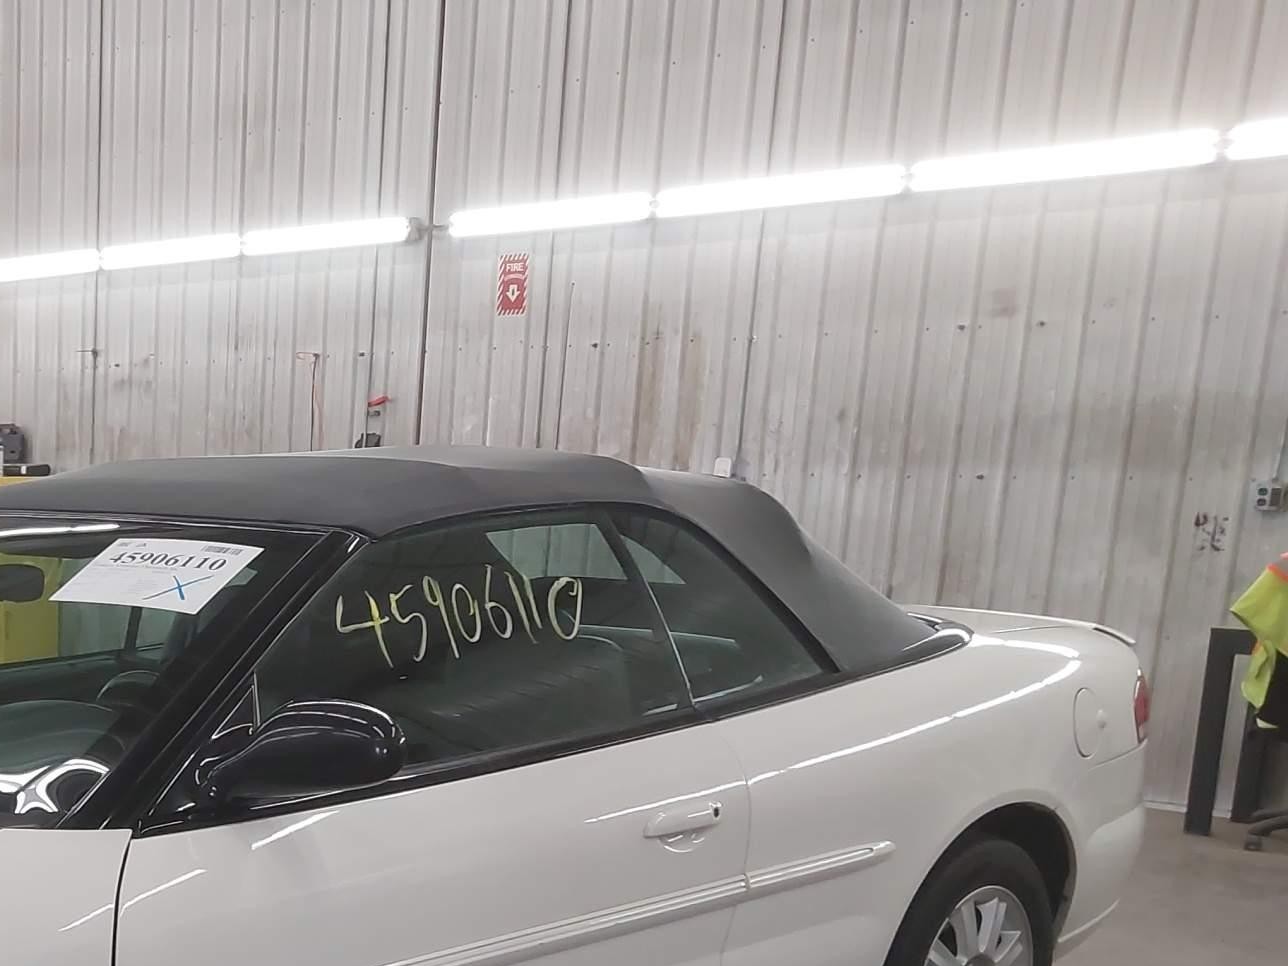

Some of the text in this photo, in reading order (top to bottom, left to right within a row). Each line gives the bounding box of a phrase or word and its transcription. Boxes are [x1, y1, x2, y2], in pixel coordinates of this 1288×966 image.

[506, 263, 524, 272] FIRE
[109, 551, 227, 572] 45906110
[336, 564, 583, 668] 45906110
